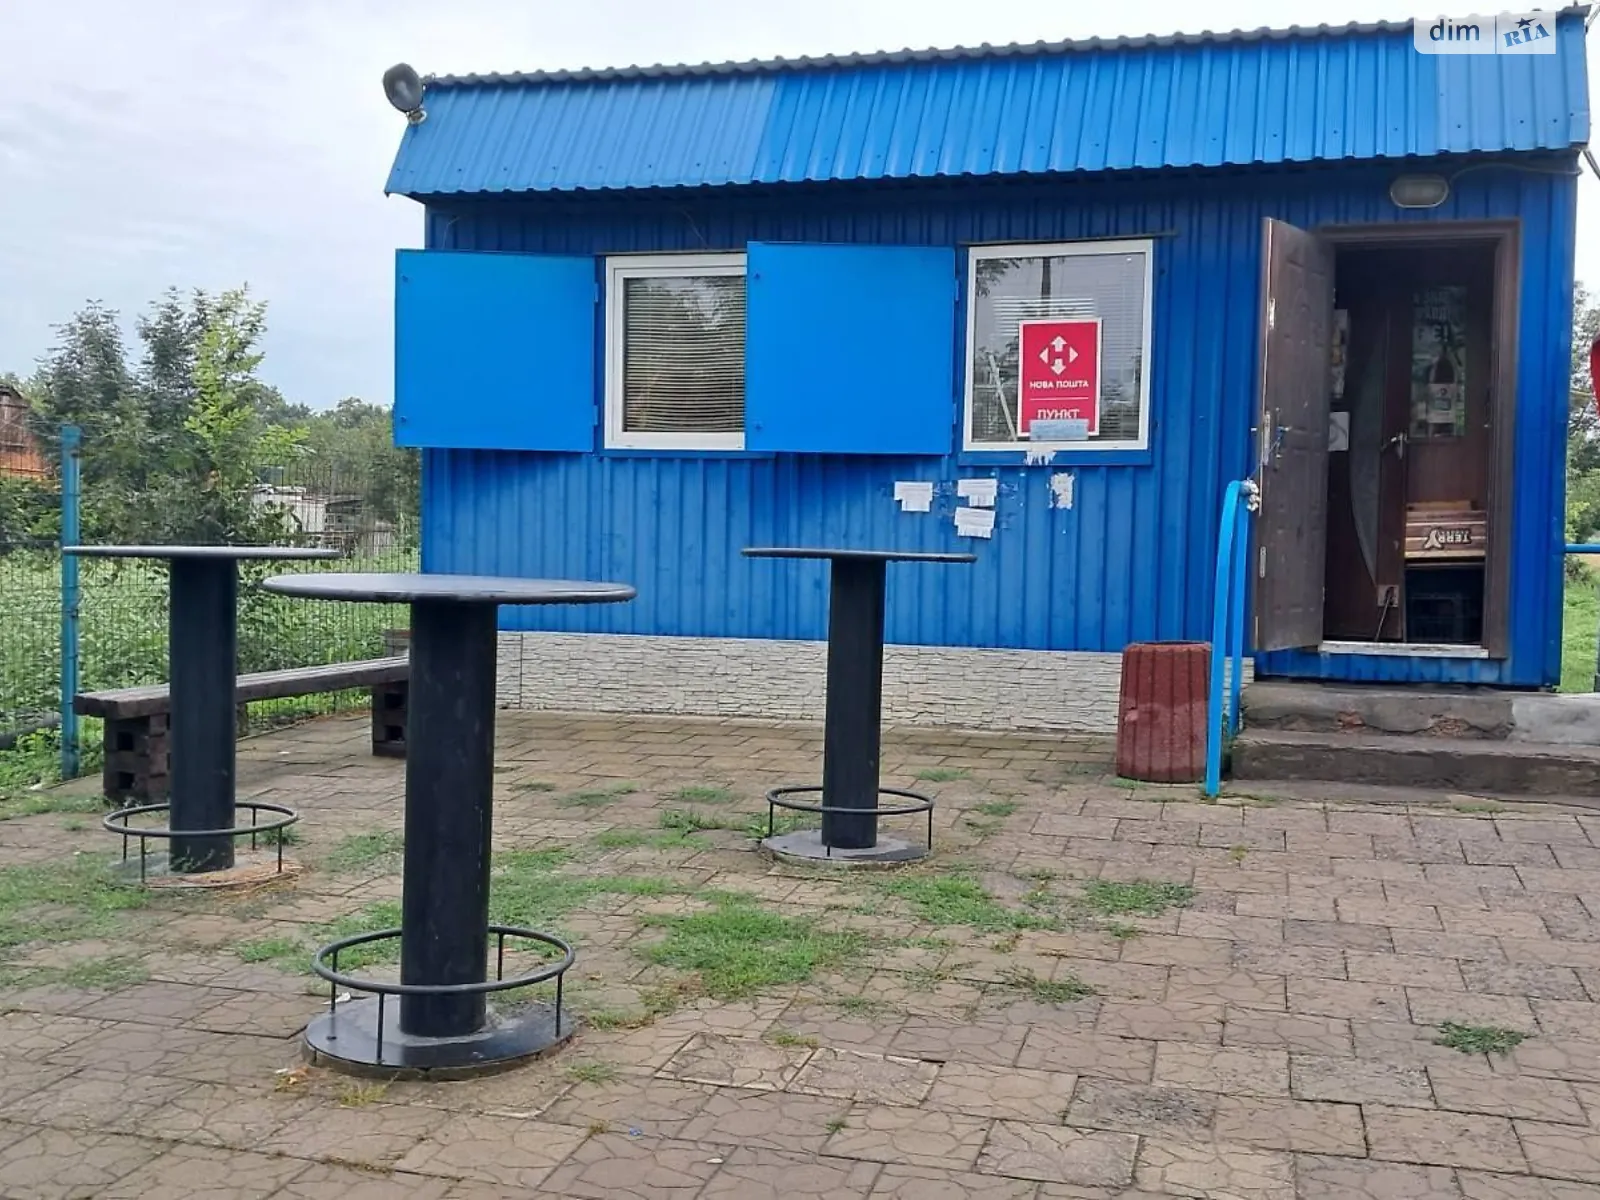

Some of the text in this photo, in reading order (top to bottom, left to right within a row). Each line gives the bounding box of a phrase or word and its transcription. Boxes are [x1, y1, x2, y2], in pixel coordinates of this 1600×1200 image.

[1030, 380, 1089, 389] НОВА ПОШТА
[1037, 408, 1080, 419] ПУНКТ
